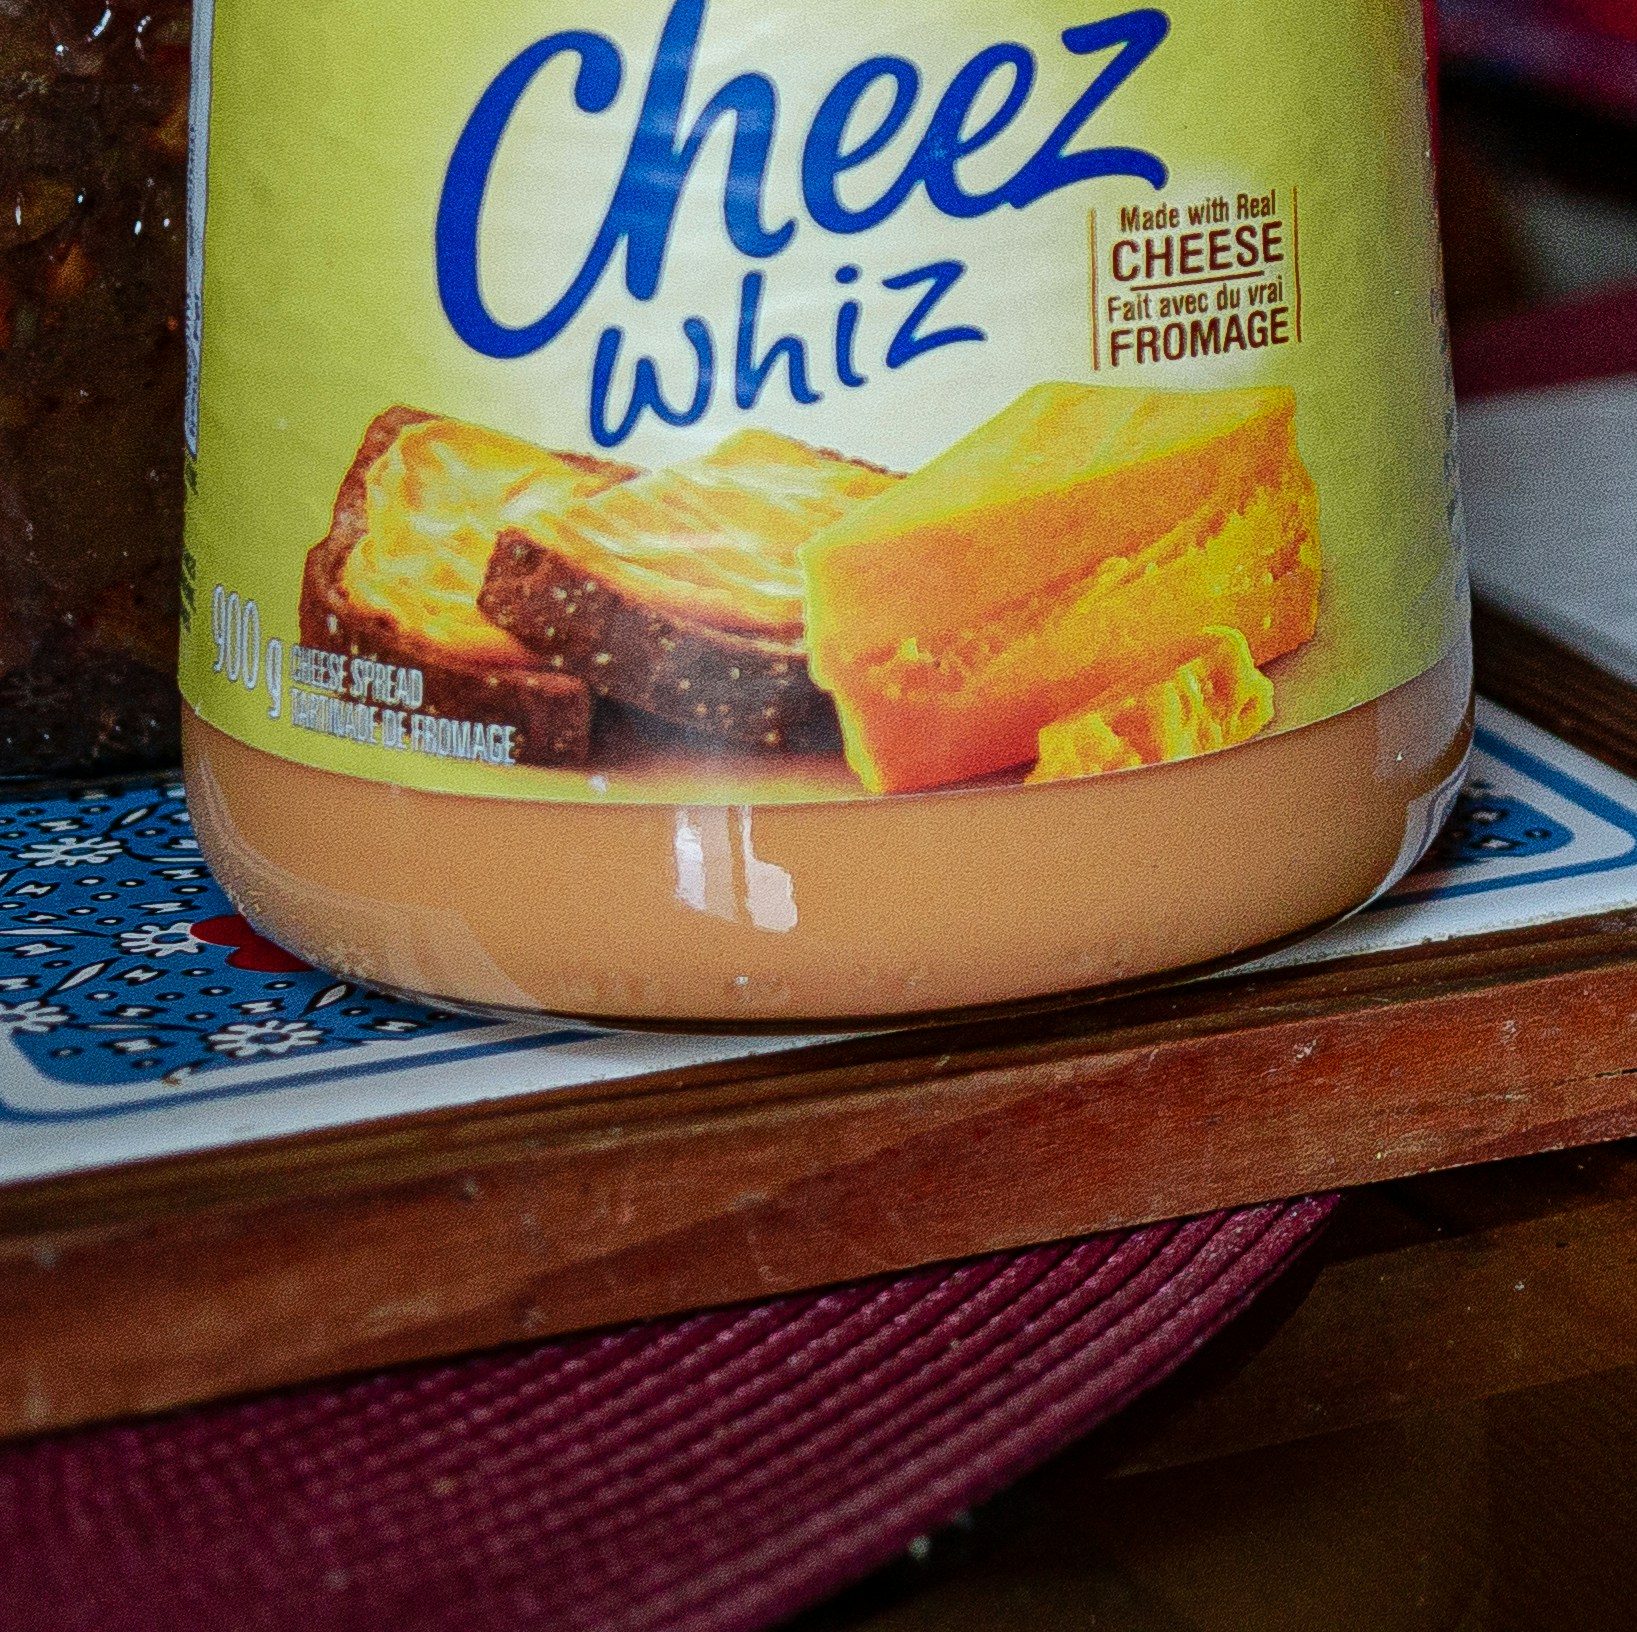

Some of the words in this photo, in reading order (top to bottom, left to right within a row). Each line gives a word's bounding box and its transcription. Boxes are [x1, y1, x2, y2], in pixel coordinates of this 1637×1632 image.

[1120, 202, 1180, 233] Made
[1188, 195, 1230, 226] with
[1236, 188, 1276, 220] Real
[1111, 220, 1285, 282] CHEESE
[1107, 293, 1152, 323] Fait
[1159, 293, 1209, 319] avec
[1216, 283, 1241, 312] du
[1248, 275, 1284, 306] vrai
[1109, 306, 1290, 367] FROMAGE
[212, 583, 261, 690] 900
[265, 637, 283, 720] g
[290, 645, 348, 698] CHEESE
[350, 658, 424, 710] SPREAD
[382, 708, 408, 751] DE
[410, 713, 517, 766] FROMAGE
